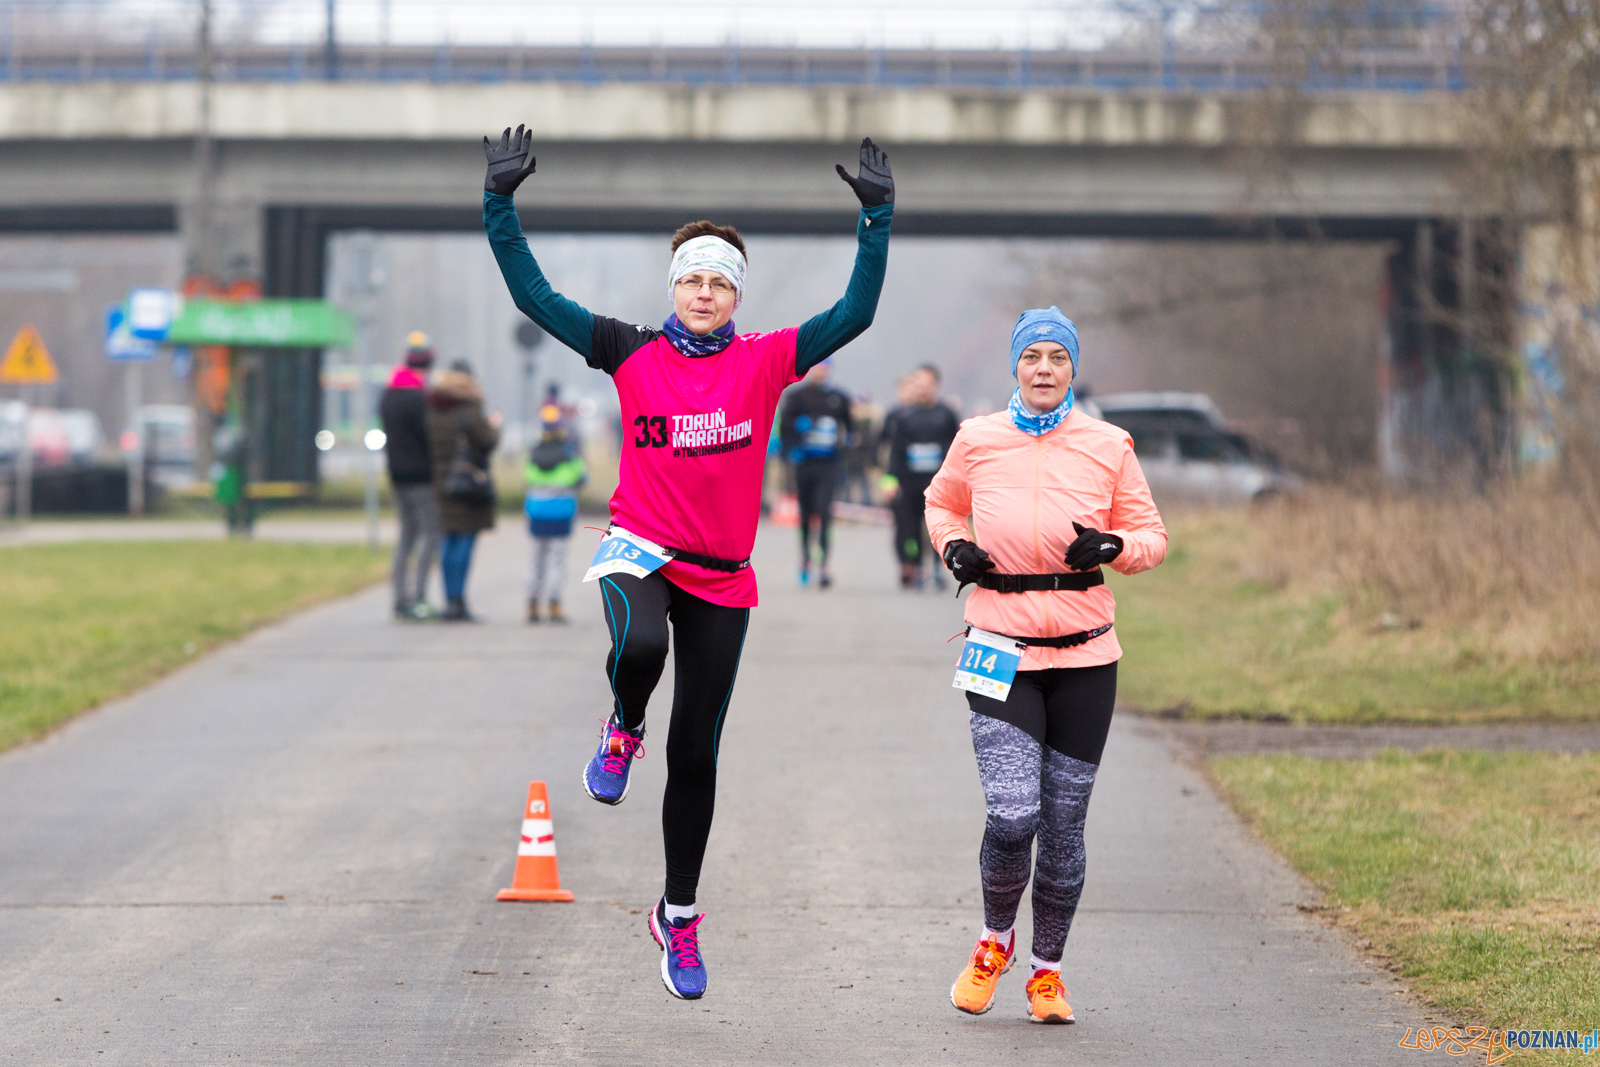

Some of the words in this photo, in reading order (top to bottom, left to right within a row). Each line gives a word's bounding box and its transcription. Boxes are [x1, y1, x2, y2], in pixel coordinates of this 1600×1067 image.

[634, 415, 669, 448] 33
[672, 408, 726, 432] TORUŃ
[672, 419, 752, 448] MARATHON
[673, 436, 752, 458] #TORUNMARATHON
[604, 540, 642, 560] 213
[964, 647, 998, 674] 214
